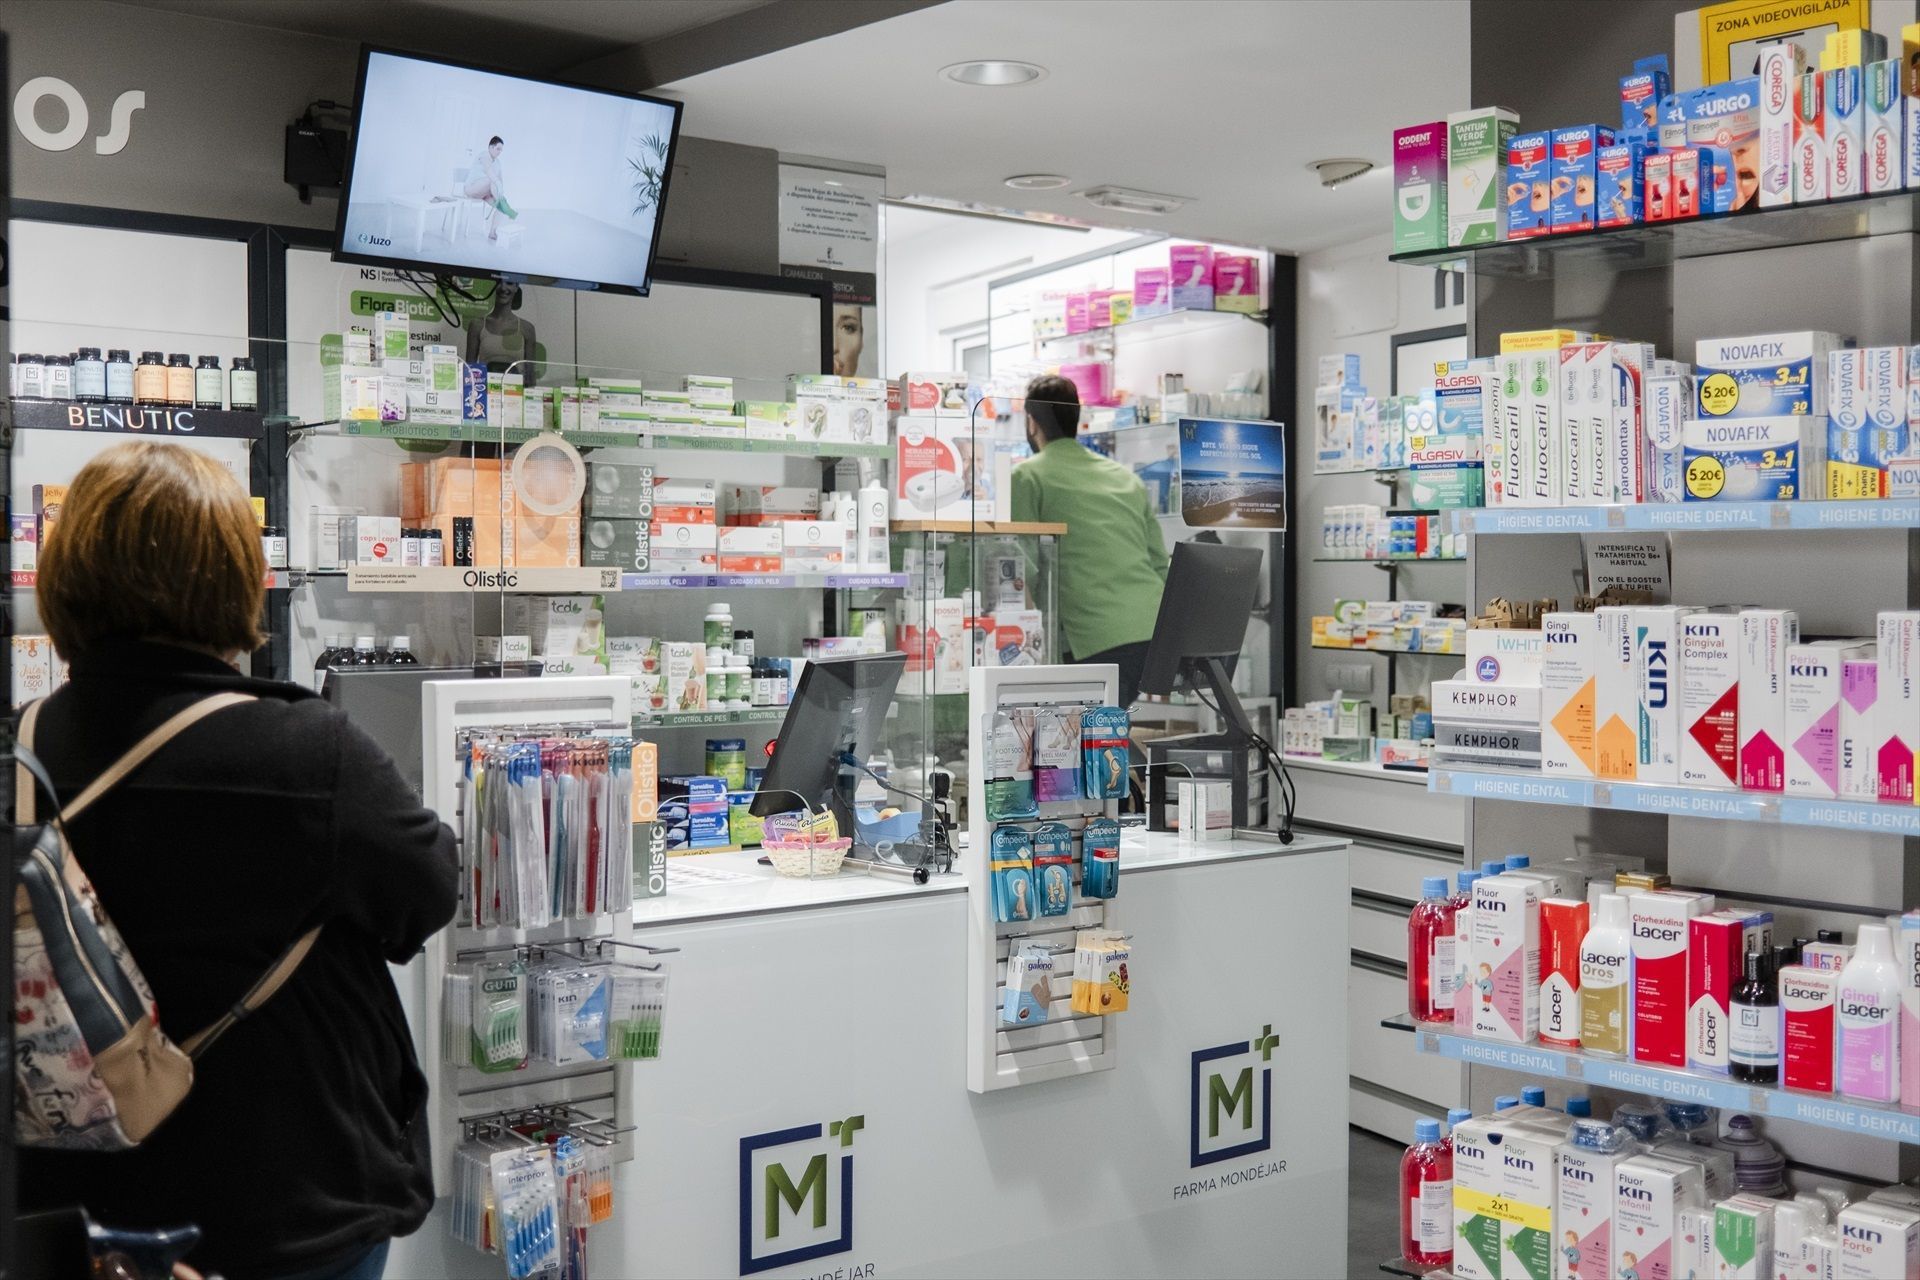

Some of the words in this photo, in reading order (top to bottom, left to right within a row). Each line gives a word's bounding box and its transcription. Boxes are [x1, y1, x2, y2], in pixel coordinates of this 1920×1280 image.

[1717, 19, 1751, 33] ZONA
[1753, 0, 1851, 28] VIDEOVIGILADA
[1630, 75, 1651, 87] URGO
[1771, 60, 1783, 109] COREGA
[1706, 93, 1751, 117] URGO
[1454, 122, 1488, 135] TANTUM
[1457, 131, 1485, 141] VERDE
[1562, 130, 1589, 143] URGO
[1398, 132, 1433, 146] ODDENT
[1518, 137, 1544, 150] URGO
[1836, 137, 1848, 186] COREGA
[1875, 133, 1887, 181] COREGA
[1803, 144, 1814, 191] COREGA
[368, 234, 391, 247] Juzo
[360, 268, 376, 281] NS
[1720, 342, 1784, 361] NOVAFIX
[1841, 353, 1854, 409] NOVAFIX
[1879, 350, 1891, 407] NOVAFIX
[1492, 378, 1502, 440] Fluocaril
[1658, 386, 1670, 444] NOVAFIX
[1792, 401, 1808, 412] 30
[68, 406, 196, 432] BENUTIC
[1707, 425, 1770, 443] NOVAFIX
[1410, 449, 1464, 462] ALGASIV
[1507, 405, 1519, 499] Fluocaril
[1535, 404, 1548, 498] Fluocaril
[1568, 418, 1579, 499] Fluocaril
[1591, 416, 1603, 498] Fluocaril
[1618, 418, 1632, 497] parodontax
[1664, 452, 1673, 490] MAS
[43, 488, 63, 498] Jelly
[639, 467, 653, 517] Olistic
[700, 491, 714, 500] MED
[1779, 485, 1795, 497] 30
[1497, 515, 1543, 528] HIGIENE
[1546, 514, 1592, 527] DENTAL
[1651, 510, 1702, 525] HIGIENE
[1705, 509, 1757, 524] DENTAL
[1820, 506, 1877, 521] HIGIENE
[381, 536, 399, 544] caps
[455, 531, 463, 559] Olistic
[565, 520, 579, 569] Olistic
[635, 520, 649, 571] Olistic
[463, 569, 518, 588] Olistic
[634, 578, 656, 586] CUIDADO
[656, 578, 671, 586] DEL
[551, 600, 572, 613] tcd
[1546, 621, 1570, 632] Gingi
[671, 646, 687, 657] tcd
[1684, 637, 1725, 650] Gingival
[1684, 648, 1728, 661] Complex
[1790, 655, 1818, 665] Perio
[1452, 691, 1519, 708] KEMPHOR
[673, 716, 704, 724] CONTROL
[705, 715, 713, 723] DE
[749, 712, 776, 720] CONTROL
[1095, 712, 1127, 728] Compeed
[1454, 733, 1520, 750] KEMPHOR
[637, 749, 655, 818] Olistic
[1474, 779, 1520, 795] HIGIENE
[1523, 783, 1569, 799] DENTAL
[1637, 792, 1689, 810] HIGIENE
[1692, 797, 1744, 815] DENTAL
[801, 812, 830, 830] Ricola
[1809, 807, 1868, 825] HIGIENE
[995, 833, 1028, 847] Compeed
[1037, 829, 1070, 844] Compeed
[648, 825, 666, 895] Olistic
[1476, 887, 1499, 898] Fluor
[1632, 913, 1685, 928] Clorhexidina
[1632, 922, 1684, 942] Lacer
[1105, 950, 1129, 964] galeno
[1581, 949, 1625, 968] Lacer
[1028, 960, 1053, 973] galeno
[1581, 965, 1615, 979] Oros
[1784, 977, 1830, 990] Clorhexidina
[1784, 984, 1829, 1002] Lacer
[1842, 987, 1880, 1006] Gingi
[1549, 985, 1561, 1033] Lacer
[1840, 998, 1890, 1020] Lacer
[1704, 1010, 1717, 1057] Lacer
[1462, 1044, 1508, 1064] HIGIENE
[1511, 1051, 1557, 1073] DENTAL
[1609, 1069, 1659, 1090] HIGIENE
[1663, 1078, 1715, 1101] DENTAL
[1797, 1102, 1856, 1126] HIGIENE
[1859, 1113, 1919, 1138] DENTAL
[1456, 1132, 1478, 1146] Fluor
[1504, 1144, 1527, 1157] Fluor
[1563, 1155, 1586, 1168] Fluor
[508, 1169, 546, 1186] interprox
[1173, 1178, 1217, 1200] FARMA
[1220, 1160, 1288, 1189] MONDÉJAR
[1619, 1173, 1644, 1187] Fluor
[1491, 1199, 1510, 1213] 2x1
[1842, 1238, 1874, 1255] Forte
